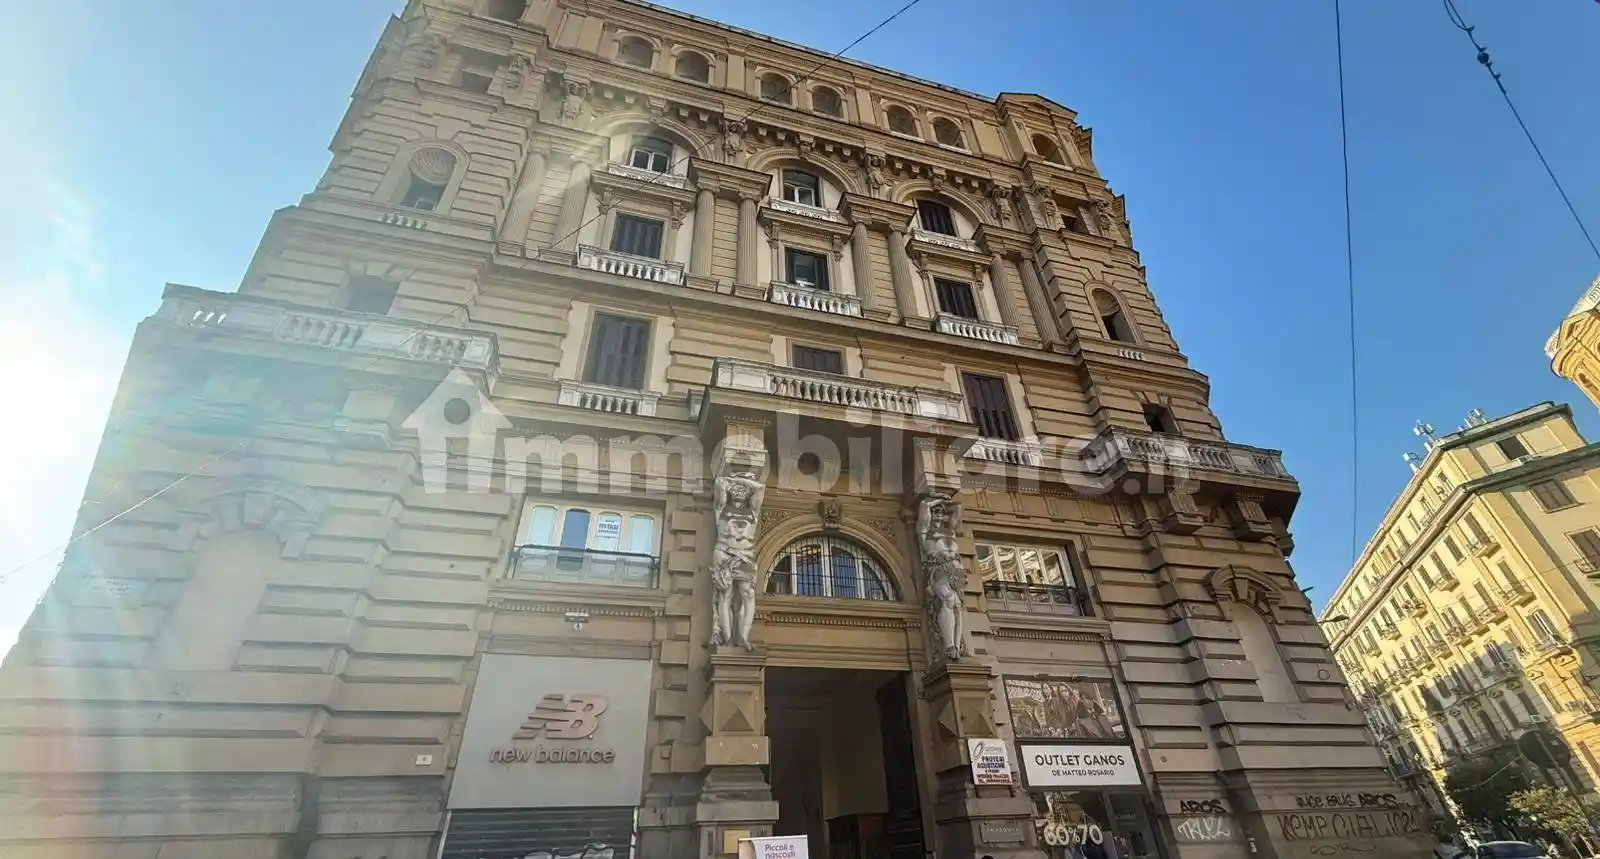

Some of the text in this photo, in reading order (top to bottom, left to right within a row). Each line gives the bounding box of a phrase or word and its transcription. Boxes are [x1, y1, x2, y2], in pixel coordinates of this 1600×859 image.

[489, 745, 616, 764] new balance
[1034, 754, 1125, 766] OUTLET GANOS
[765, 844, 788, 852] Piccoli
